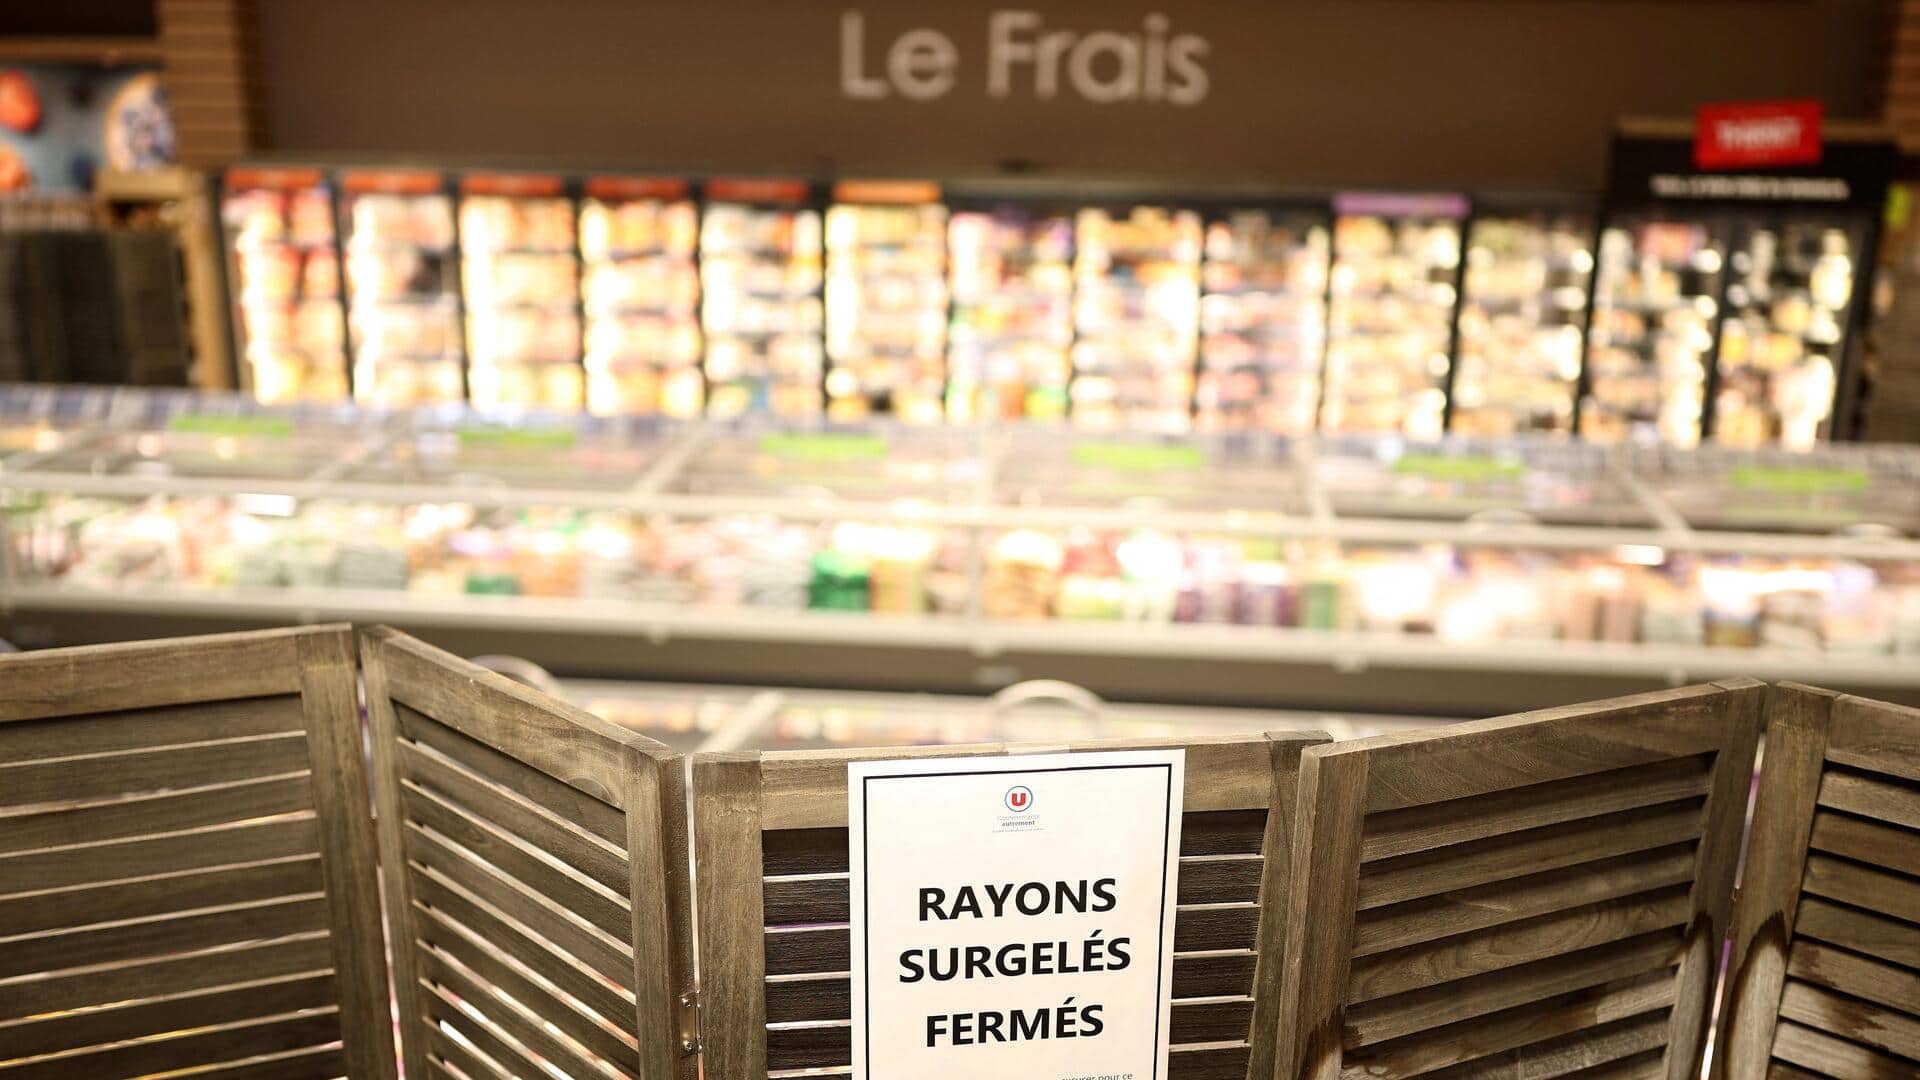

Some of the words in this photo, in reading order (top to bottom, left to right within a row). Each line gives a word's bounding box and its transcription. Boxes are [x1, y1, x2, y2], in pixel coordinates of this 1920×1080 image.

[840, 11, 958, 99] Le
[988, 11, 1209, 104] Frais
[1011, 793, 1026, 806] U
[918, 878, 1117, 922] RAYONS
[899, 929, 1131, 983] SURGELÉS
[926, 996, 1104, 1048] FERMÉS
